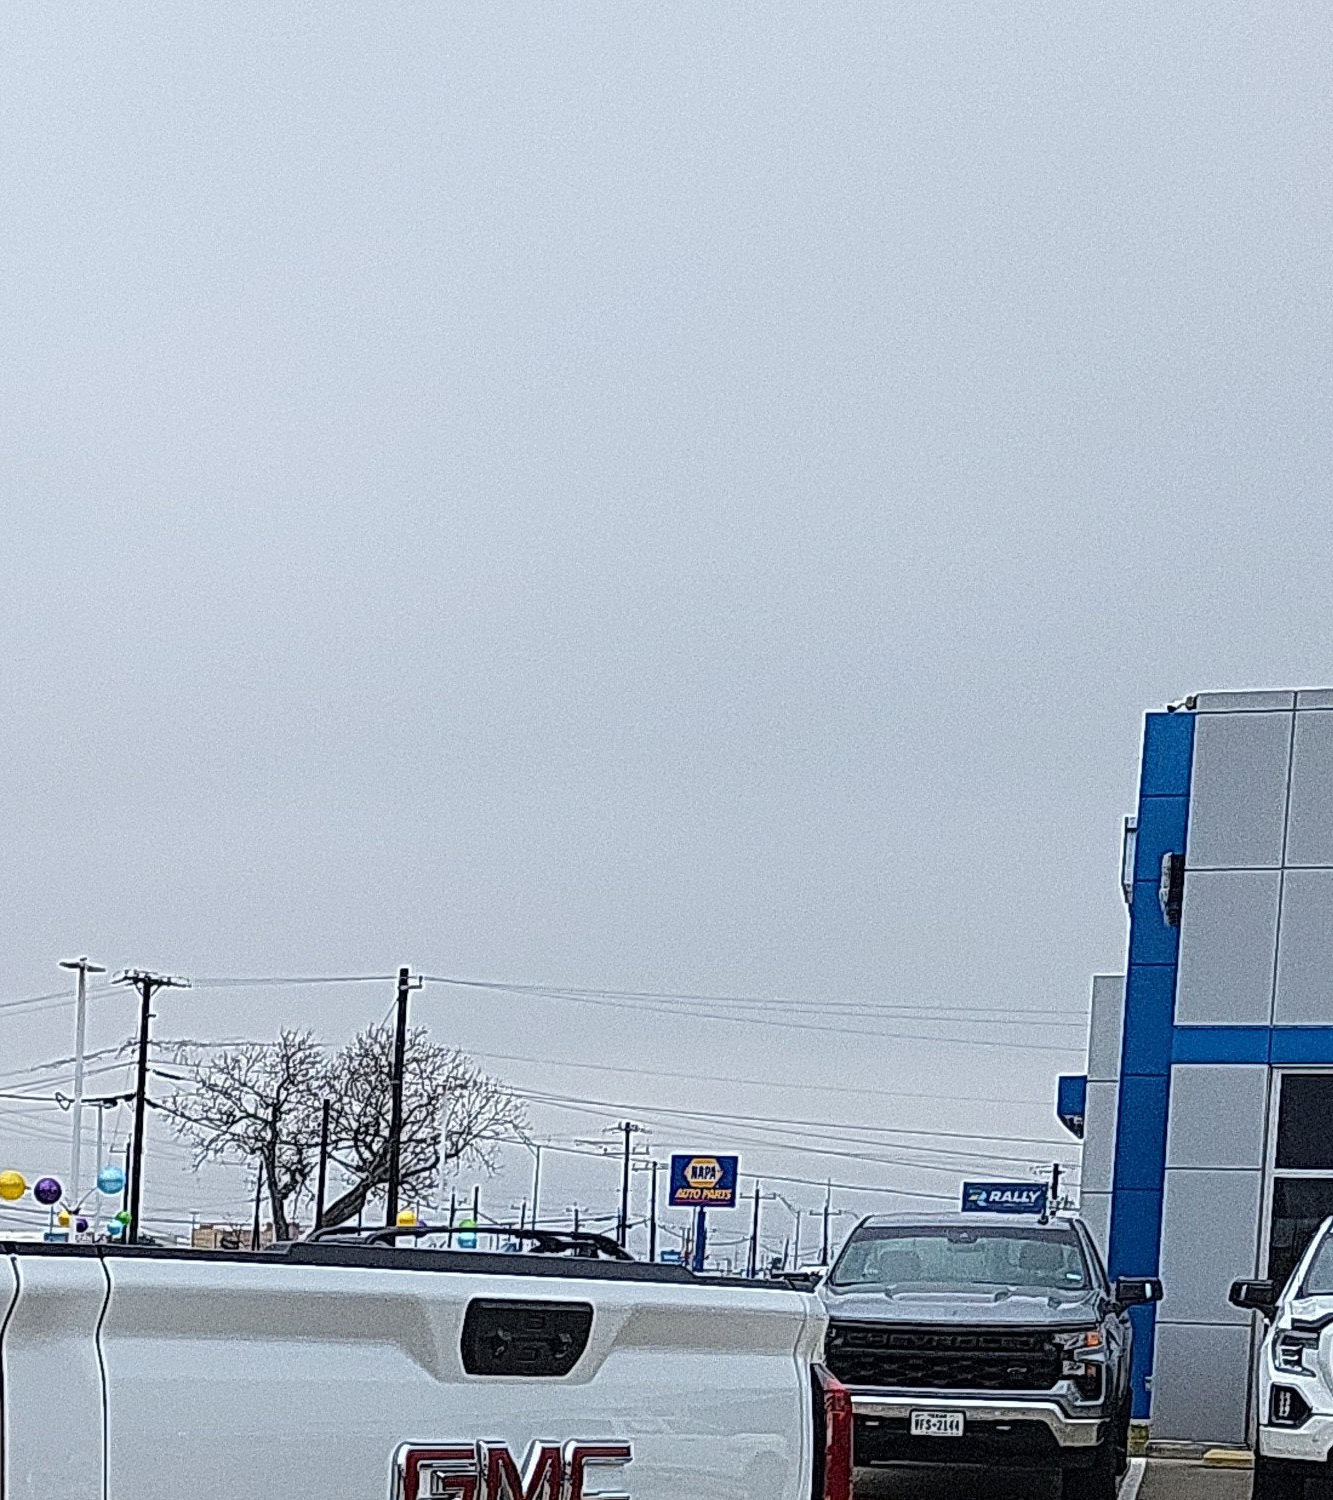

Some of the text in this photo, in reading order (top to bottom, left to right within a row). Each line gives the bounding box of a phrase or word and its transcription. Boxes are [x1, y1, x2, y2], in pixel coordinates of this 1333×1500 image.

[691, 1165, 716, 1180] NAPA
[675, 1188, 732, 1200] AUTO PARTS
[988, 1190, 1041, 1203] RALLY
